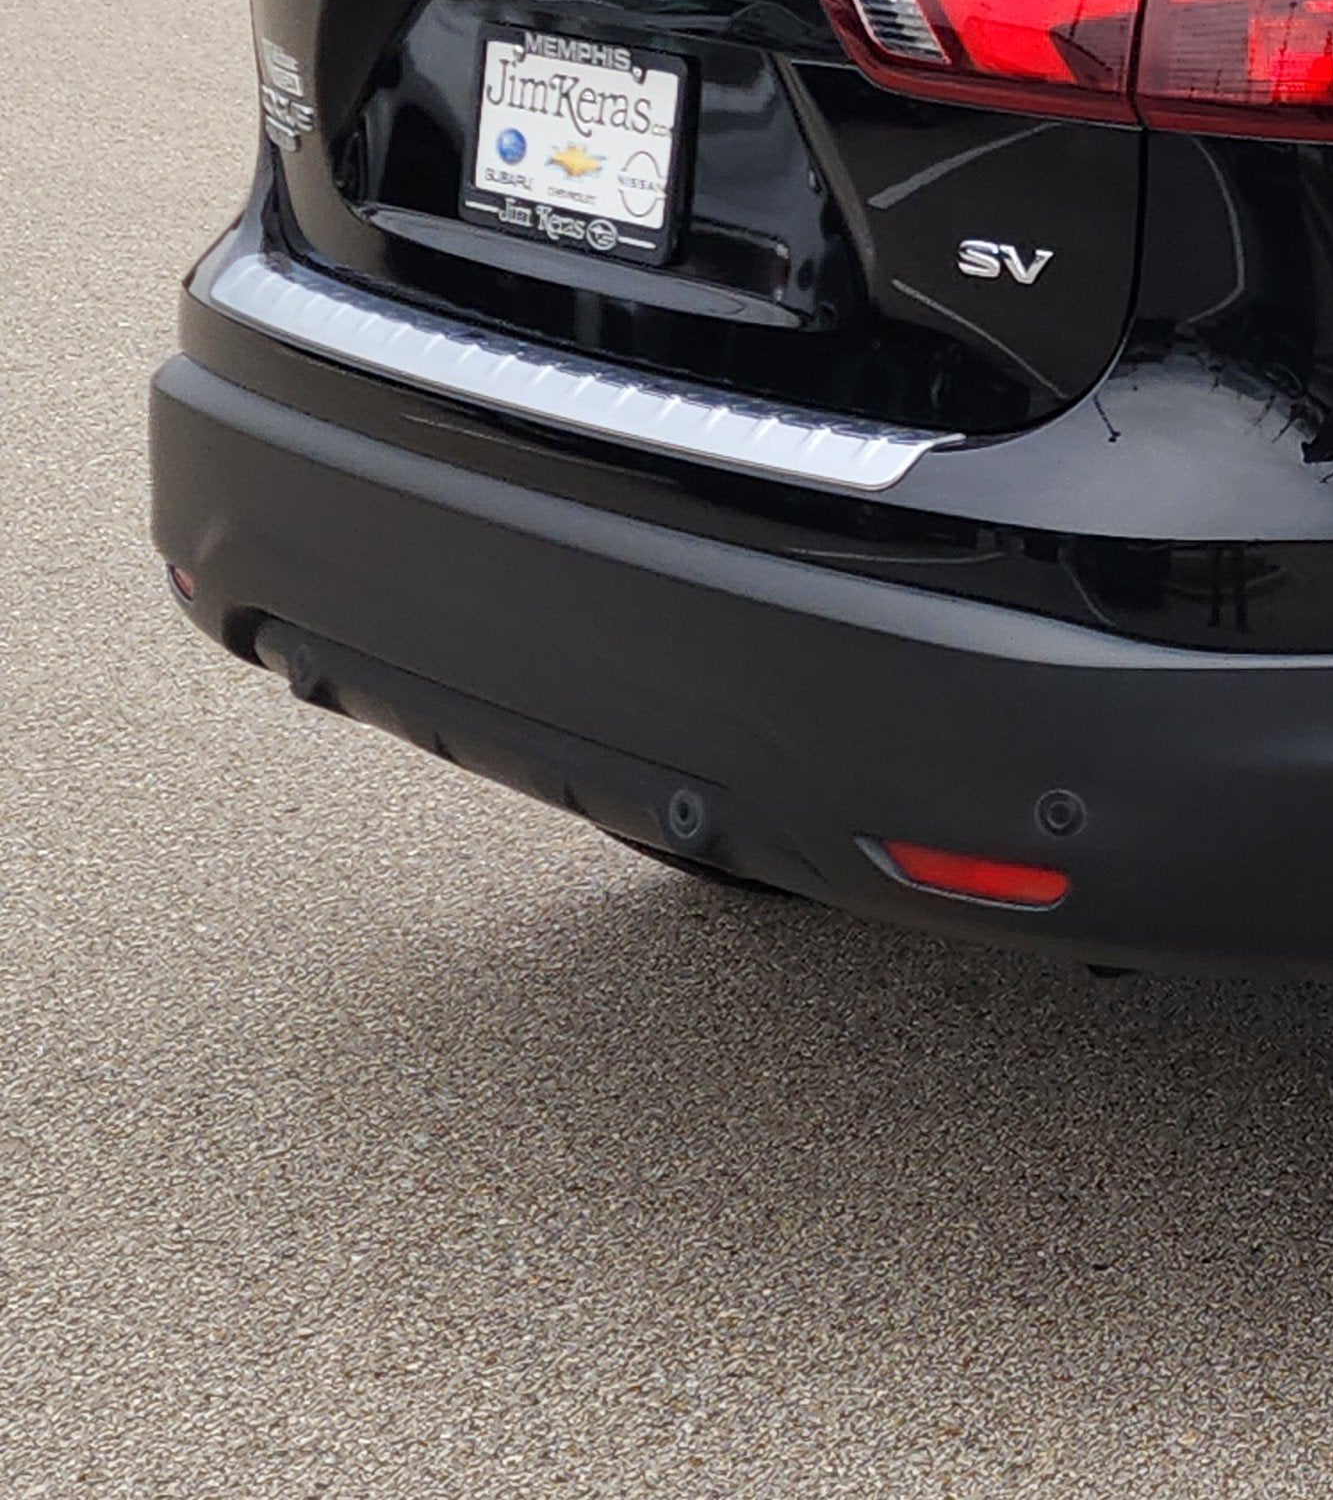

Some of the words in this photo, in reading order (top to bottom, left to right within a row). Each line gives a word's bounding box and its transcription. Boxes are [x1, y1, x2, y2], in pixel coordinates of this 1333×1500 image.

[524, 31, 632, 71] MEMPHIS
[499, 197, 532, 228] Jim
[535, 204, 585, 241] Keras
[958, 239, 1054, 285] SV
